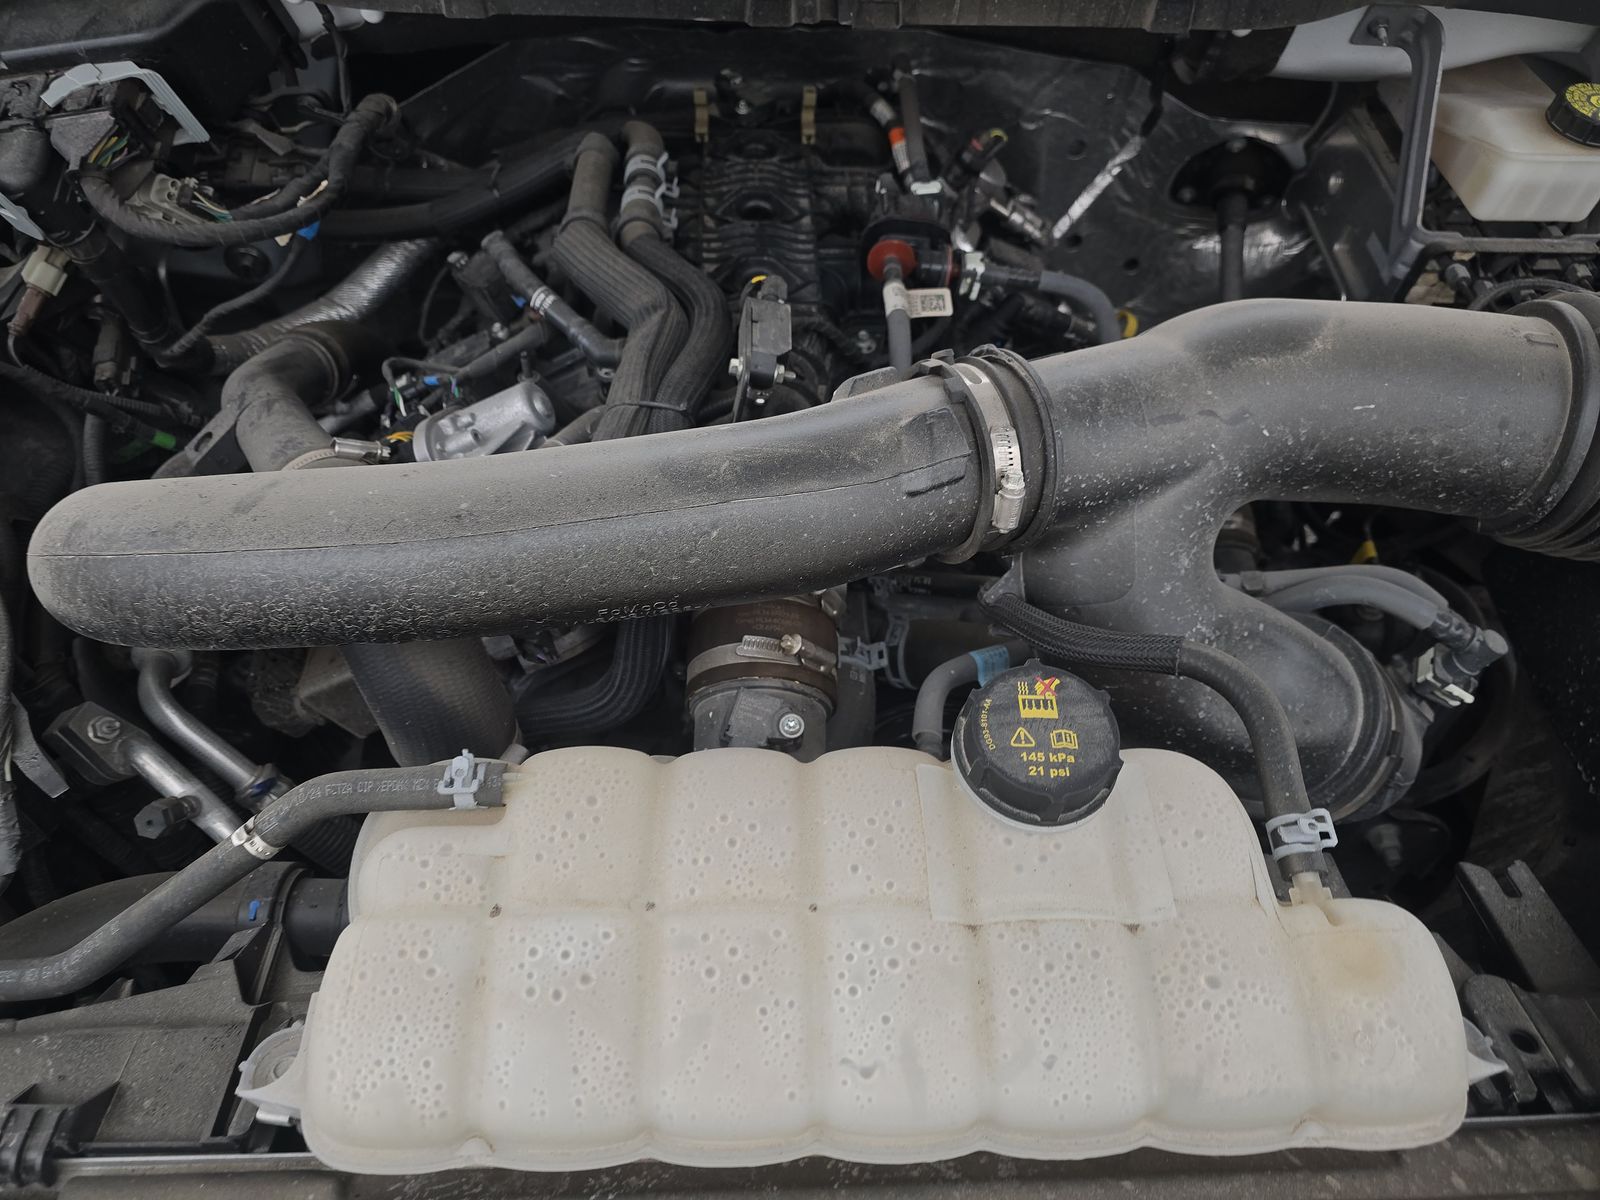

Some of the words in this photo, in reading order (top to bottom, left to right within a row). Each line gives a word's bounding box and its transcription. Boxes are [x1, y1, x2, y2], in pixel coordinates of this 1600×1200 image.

[1020, 751, 1046, 763] 145
[1048, 751, 1075, 764] kPa
[1028, 765, 1045, 777] 21
[1049, 766, 1070, 779] psi
